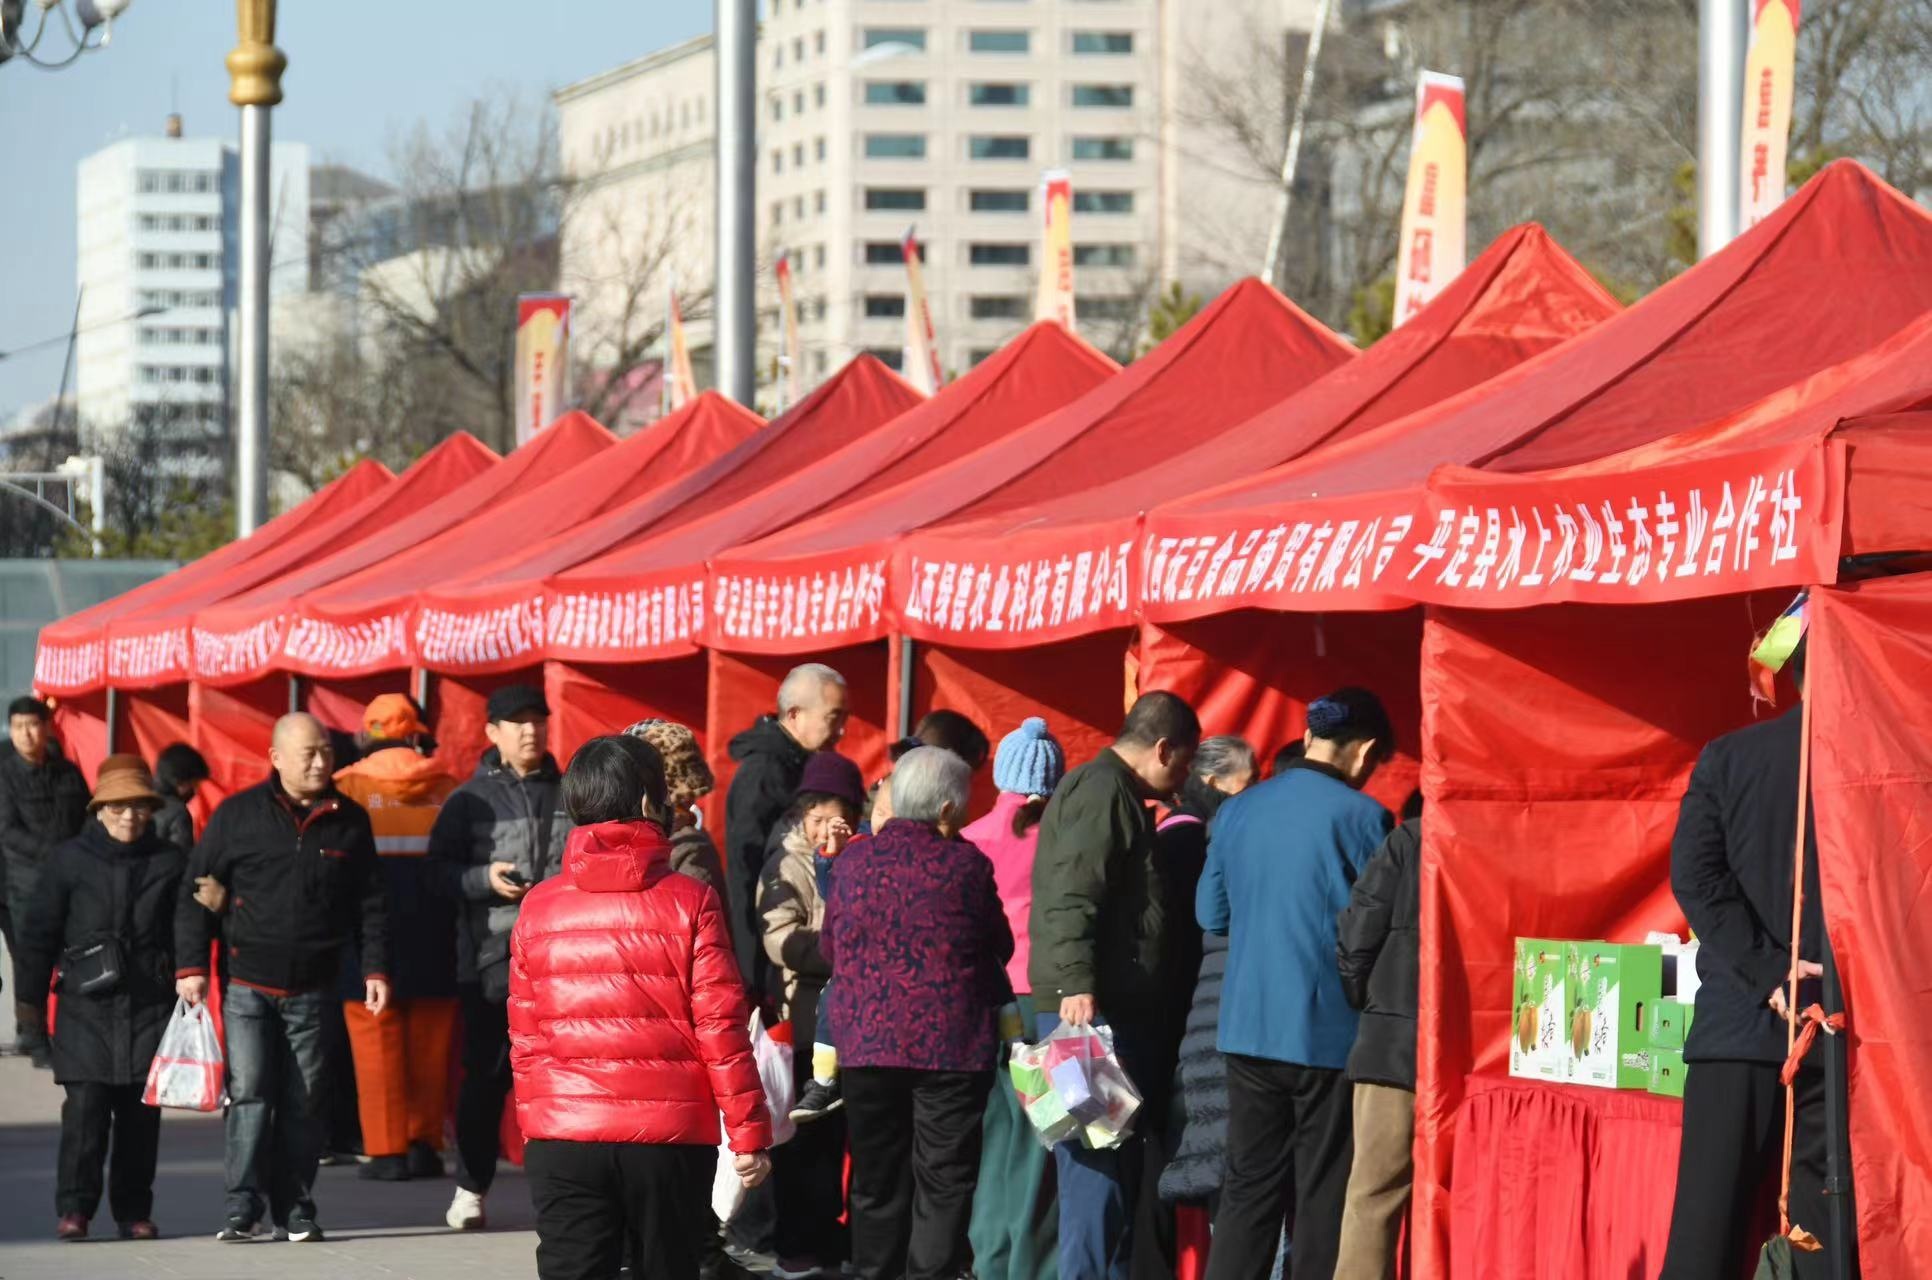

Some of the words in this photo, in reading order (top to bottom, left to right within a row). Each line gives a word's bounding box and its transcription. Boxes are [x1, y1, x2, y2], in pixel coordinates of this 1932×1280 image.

[1407, 469, 1801, 590] 平定县水上农业生态专业合作社
